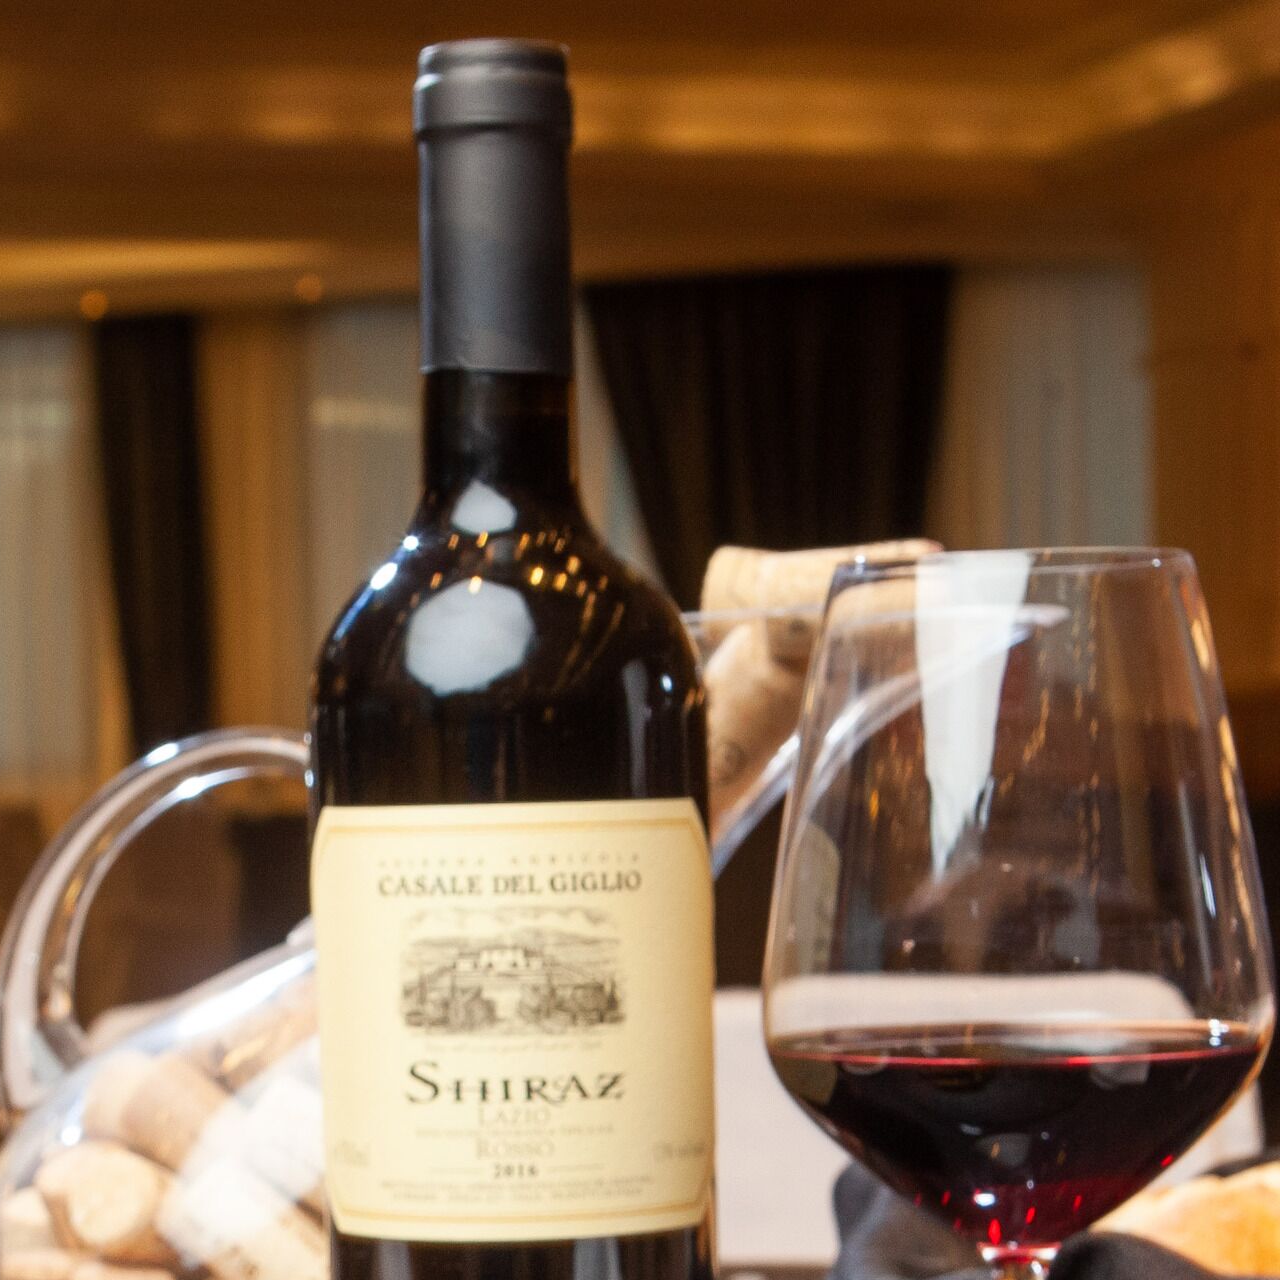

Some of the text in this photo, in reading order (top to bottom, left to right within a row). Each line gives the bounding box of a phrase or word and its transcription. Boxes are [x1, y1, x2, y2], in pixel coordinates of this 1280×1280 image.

[378, 869, 643, 897] CASALE DEL GIGLIO
[406, 1060, 625, 1105] SHIRAZ
